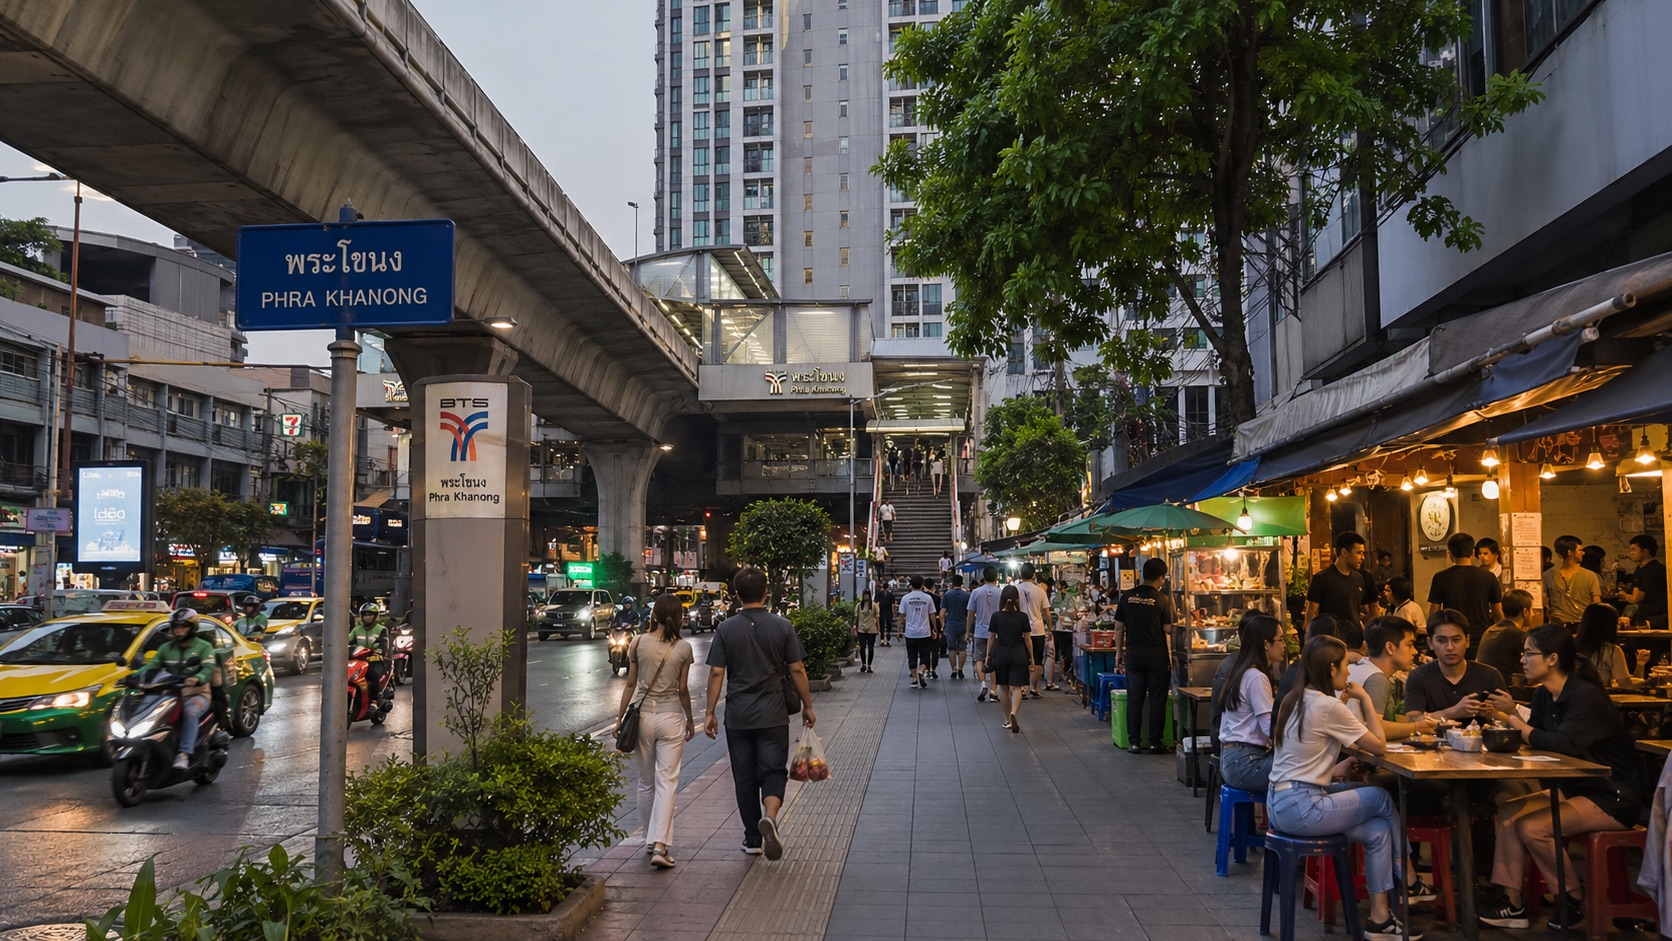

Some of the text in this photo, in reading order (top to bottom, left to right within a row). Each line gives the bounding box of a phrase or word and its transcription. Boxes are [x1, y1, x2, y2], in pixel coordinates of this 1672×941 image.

[285, 239, 402, 275] พระโขนง
[261, 287, 428, 309] PHRA KHANONG
[440, 398, 489, 408] BTS
[440, 473, 487, 488] พระโขนง
[429, 492, 500, 504] Phra Khanong
